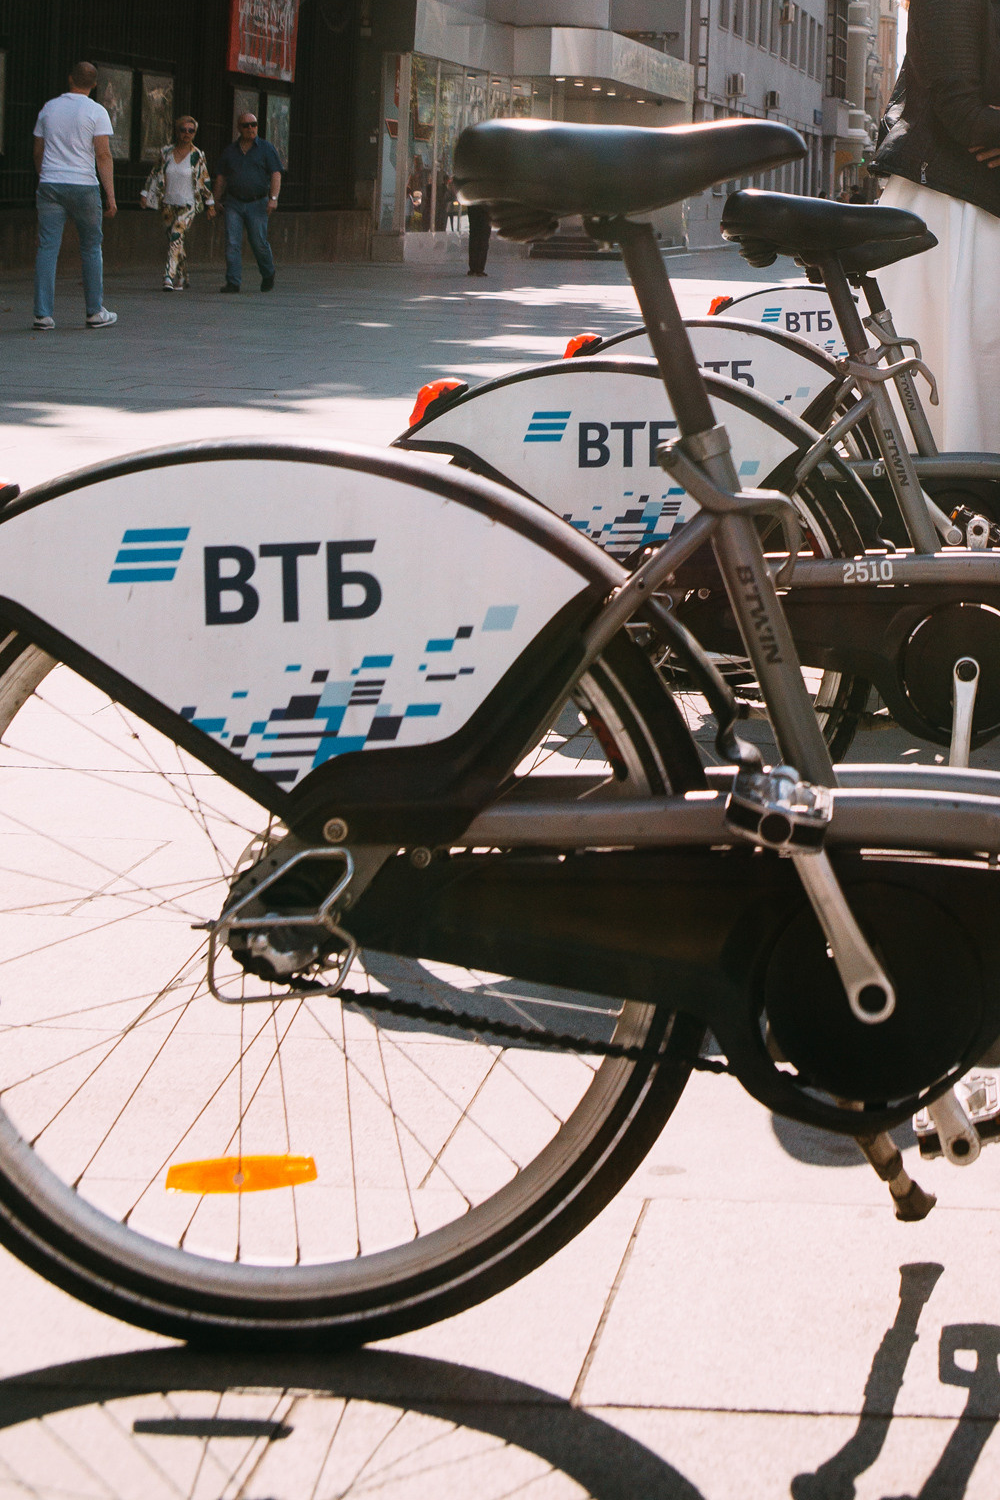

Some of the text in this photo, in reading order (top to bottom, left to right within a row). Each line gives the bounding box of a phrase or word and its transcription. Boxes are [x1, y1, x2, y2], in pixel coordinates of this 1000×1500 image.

[785, 310, 833, 333] ВТБ
[697, 360, 755, 389] ТБ
[204, 538, 382, 626] ВТБ
[842, 560, 894, 584] 2510
